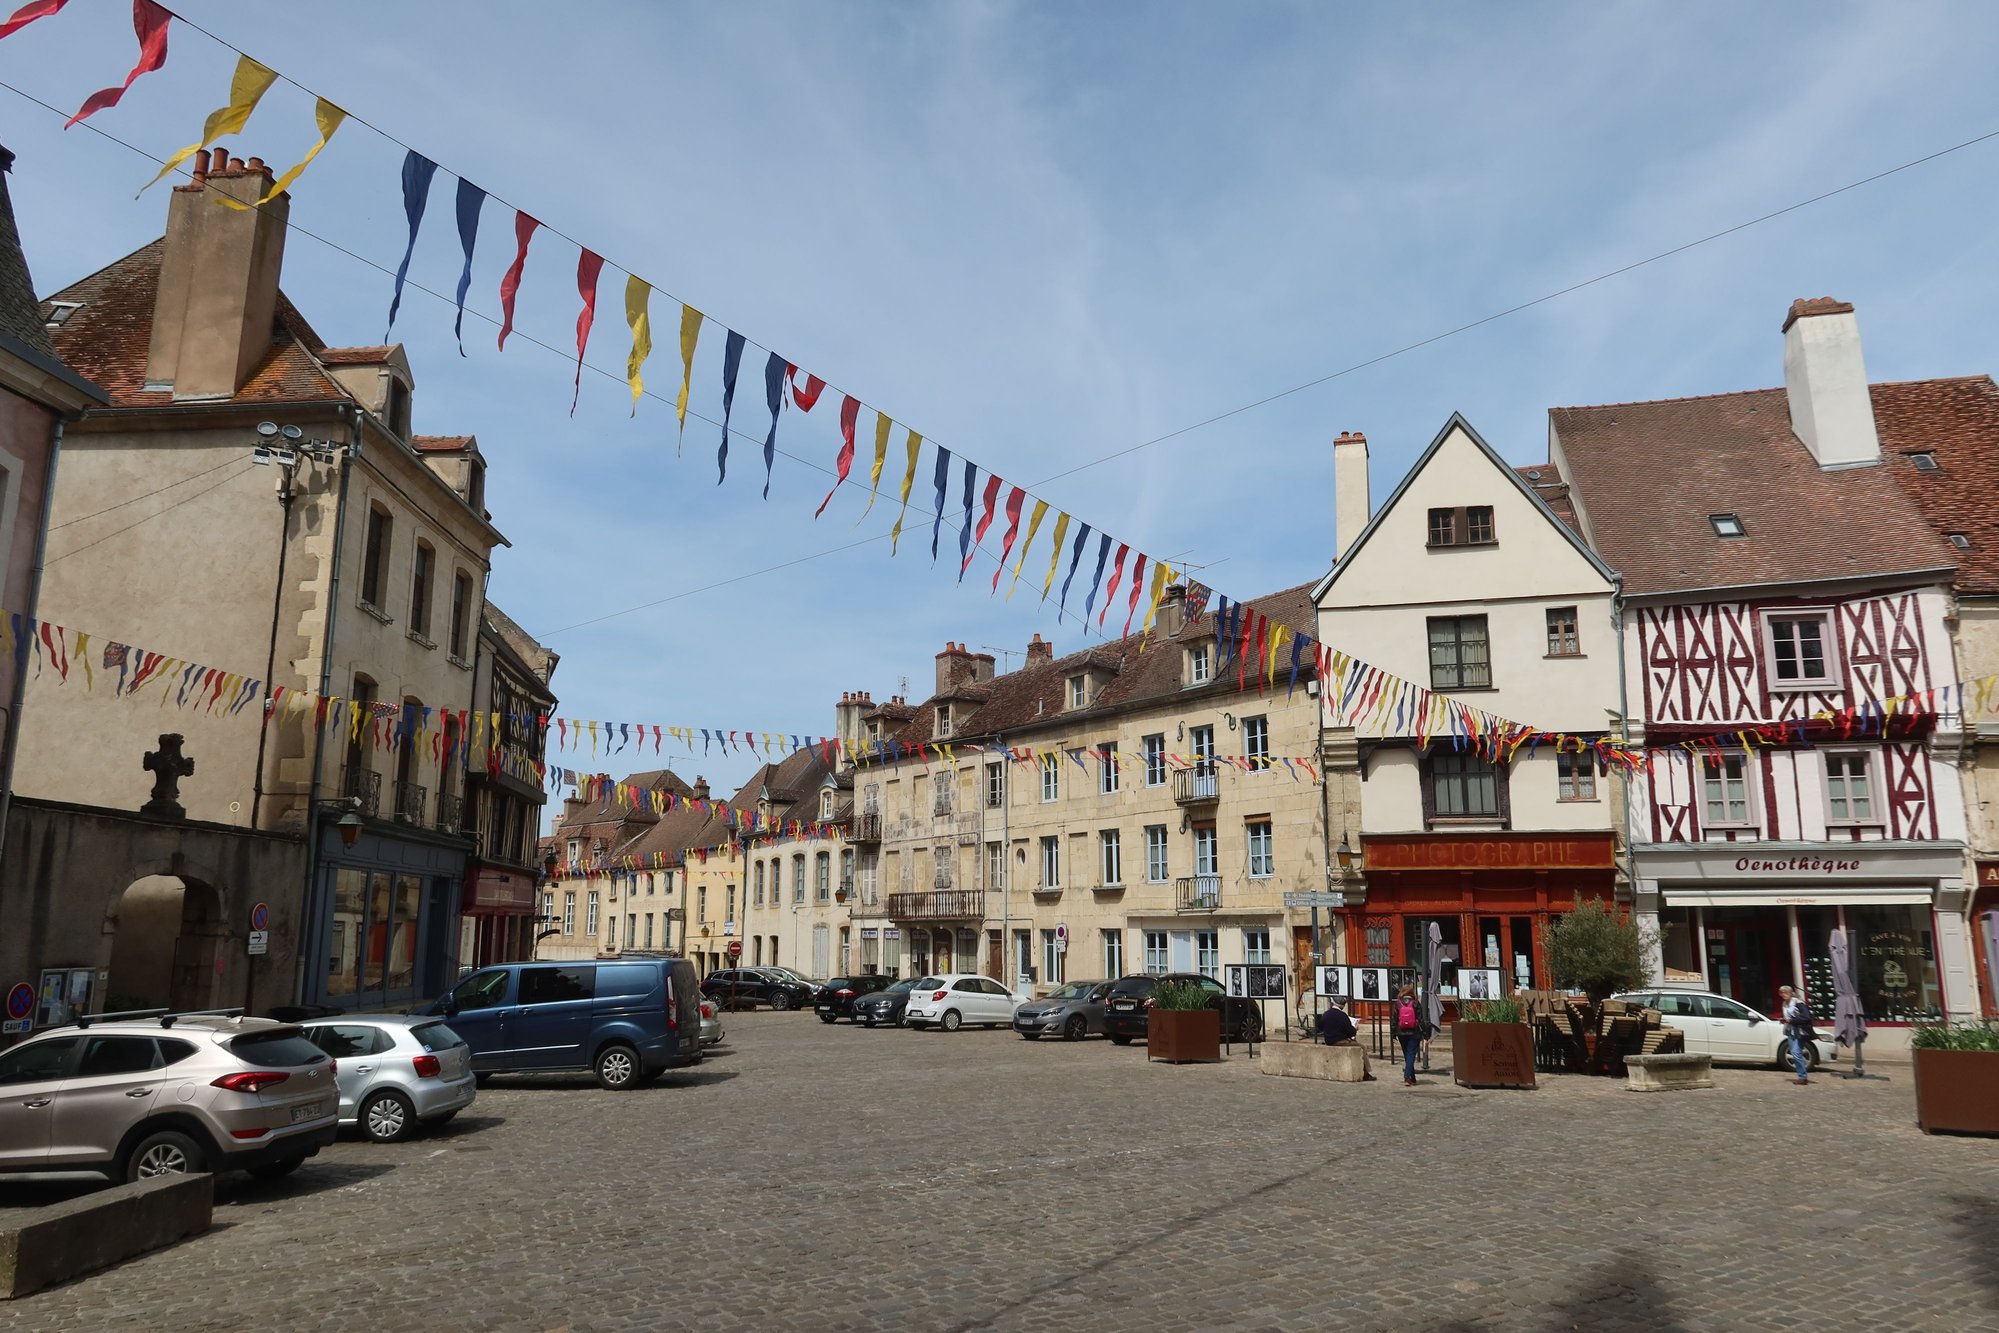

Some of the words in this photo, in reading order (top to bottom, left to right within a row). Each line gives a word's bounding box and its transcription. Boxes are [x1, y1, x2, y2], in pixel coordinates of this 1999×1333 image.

[1398, 842, 1580, 864] PHOTOGRAPHE
[1735, 856, 1860, 874] Oenothèque
[1871, 932, 1889, 942] CAVE
[4, 1022, 22, 1031] SAUF
